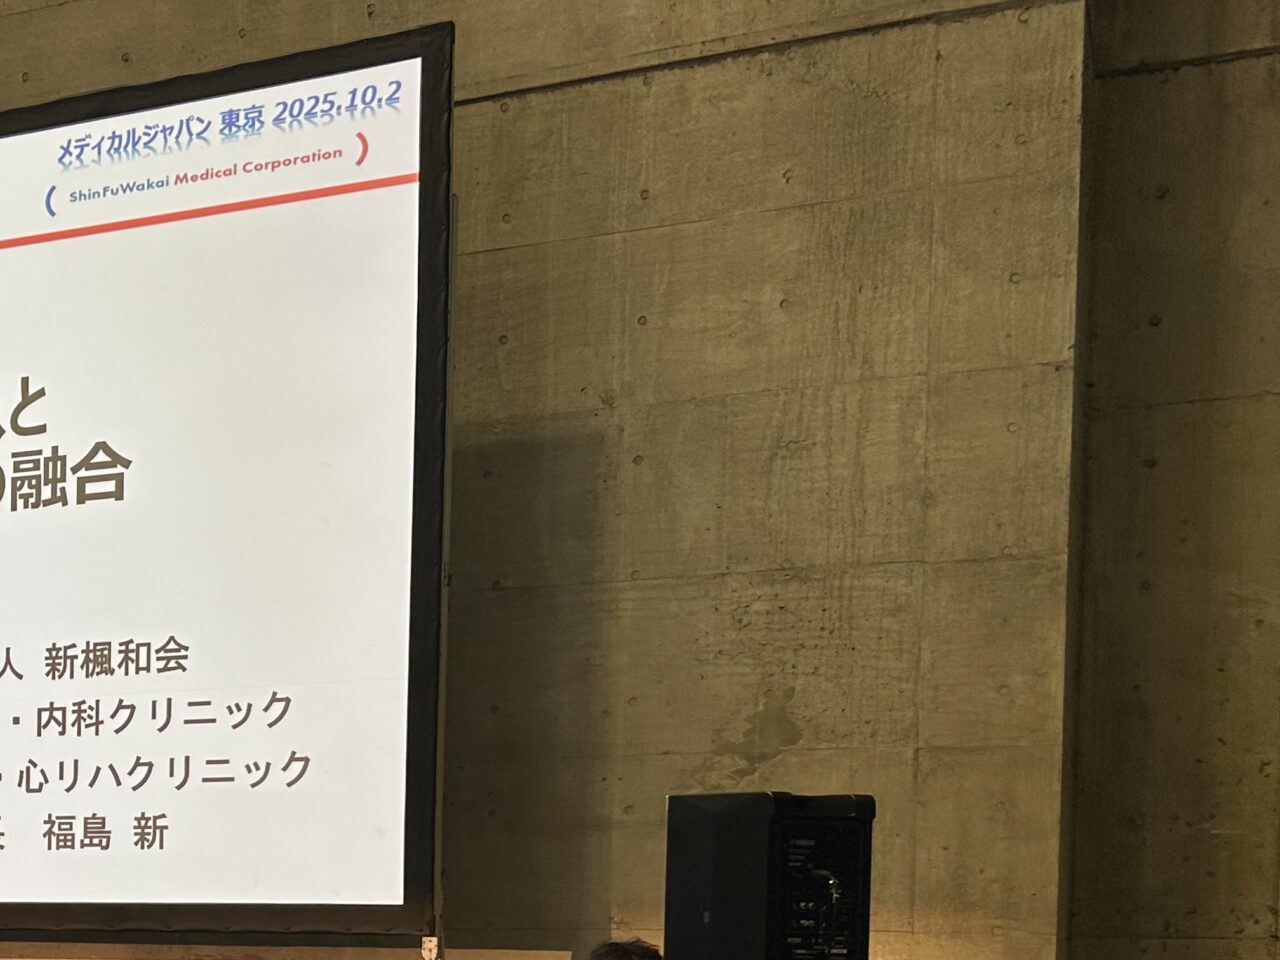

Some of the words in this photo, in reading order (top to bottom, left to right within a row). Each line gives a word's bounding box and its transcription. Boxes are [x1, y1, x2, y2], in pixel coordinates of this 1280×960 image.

[58, 114, 212, 164] メディカルジャパン
[219, 104, 265, 134] 東京
[272, 80, 402, 125] 2025.10.2
[69, 175, 170, 203] ShinFuWakai
[174, 164, 238, 186] Medical
[242, 147, 343, 175] Corporation
[45, 636, 190, 680] 新楓和会
[43, 813, 112, 851] 福島
[133, 812, 169, 850] 新
